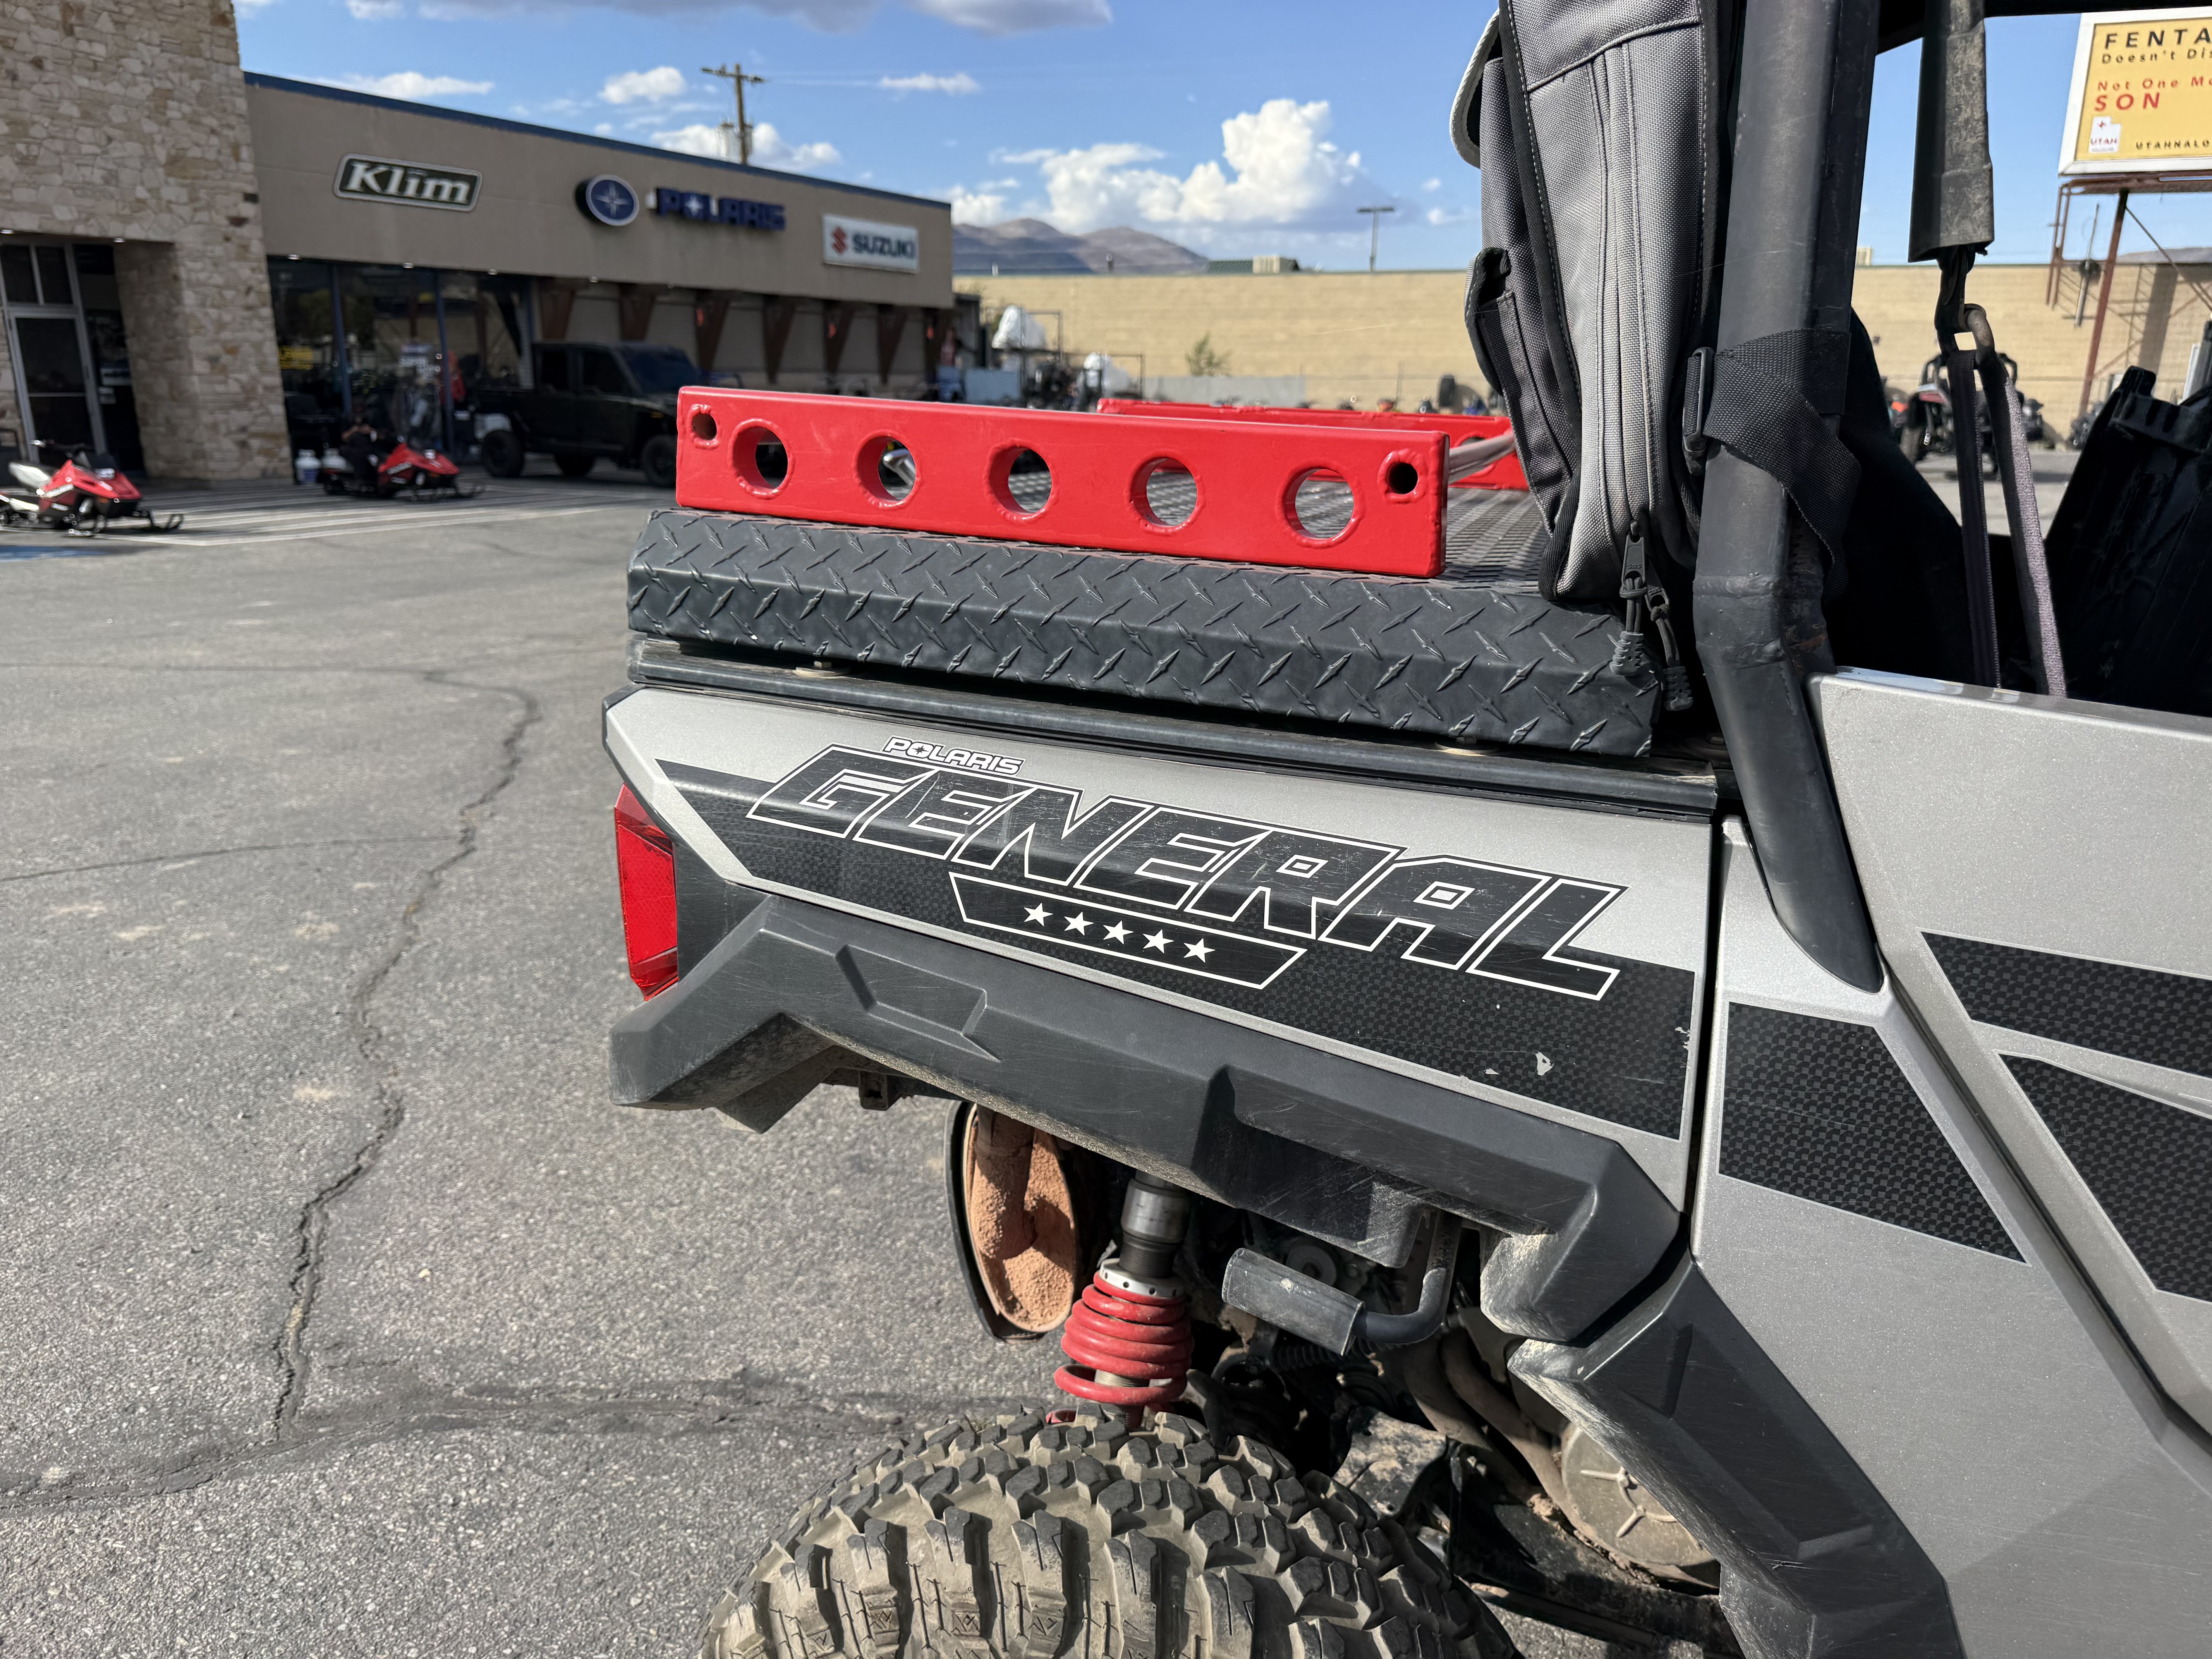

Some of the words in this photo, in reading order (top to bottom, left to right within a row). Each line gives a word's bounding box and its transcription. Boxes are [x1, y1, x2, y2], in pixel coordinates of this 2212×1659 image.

[2104, 27, 2211, 50] FENTA
[2102, 50, 2175, 64] Doesn't
[2097, 81, 2129, 91] Not
[2142, 78, 2178, 89] One
[2094, 92, 2160, 112] SON
[345, 161, 470, 203] Klim
[656, 188, 785, 230] POLARIS
[853, 233, 915, 259] SUZUKI
[883, 736, 1025, 775] POLARIS
[747, 744, 1628, 1000] GENERAL
